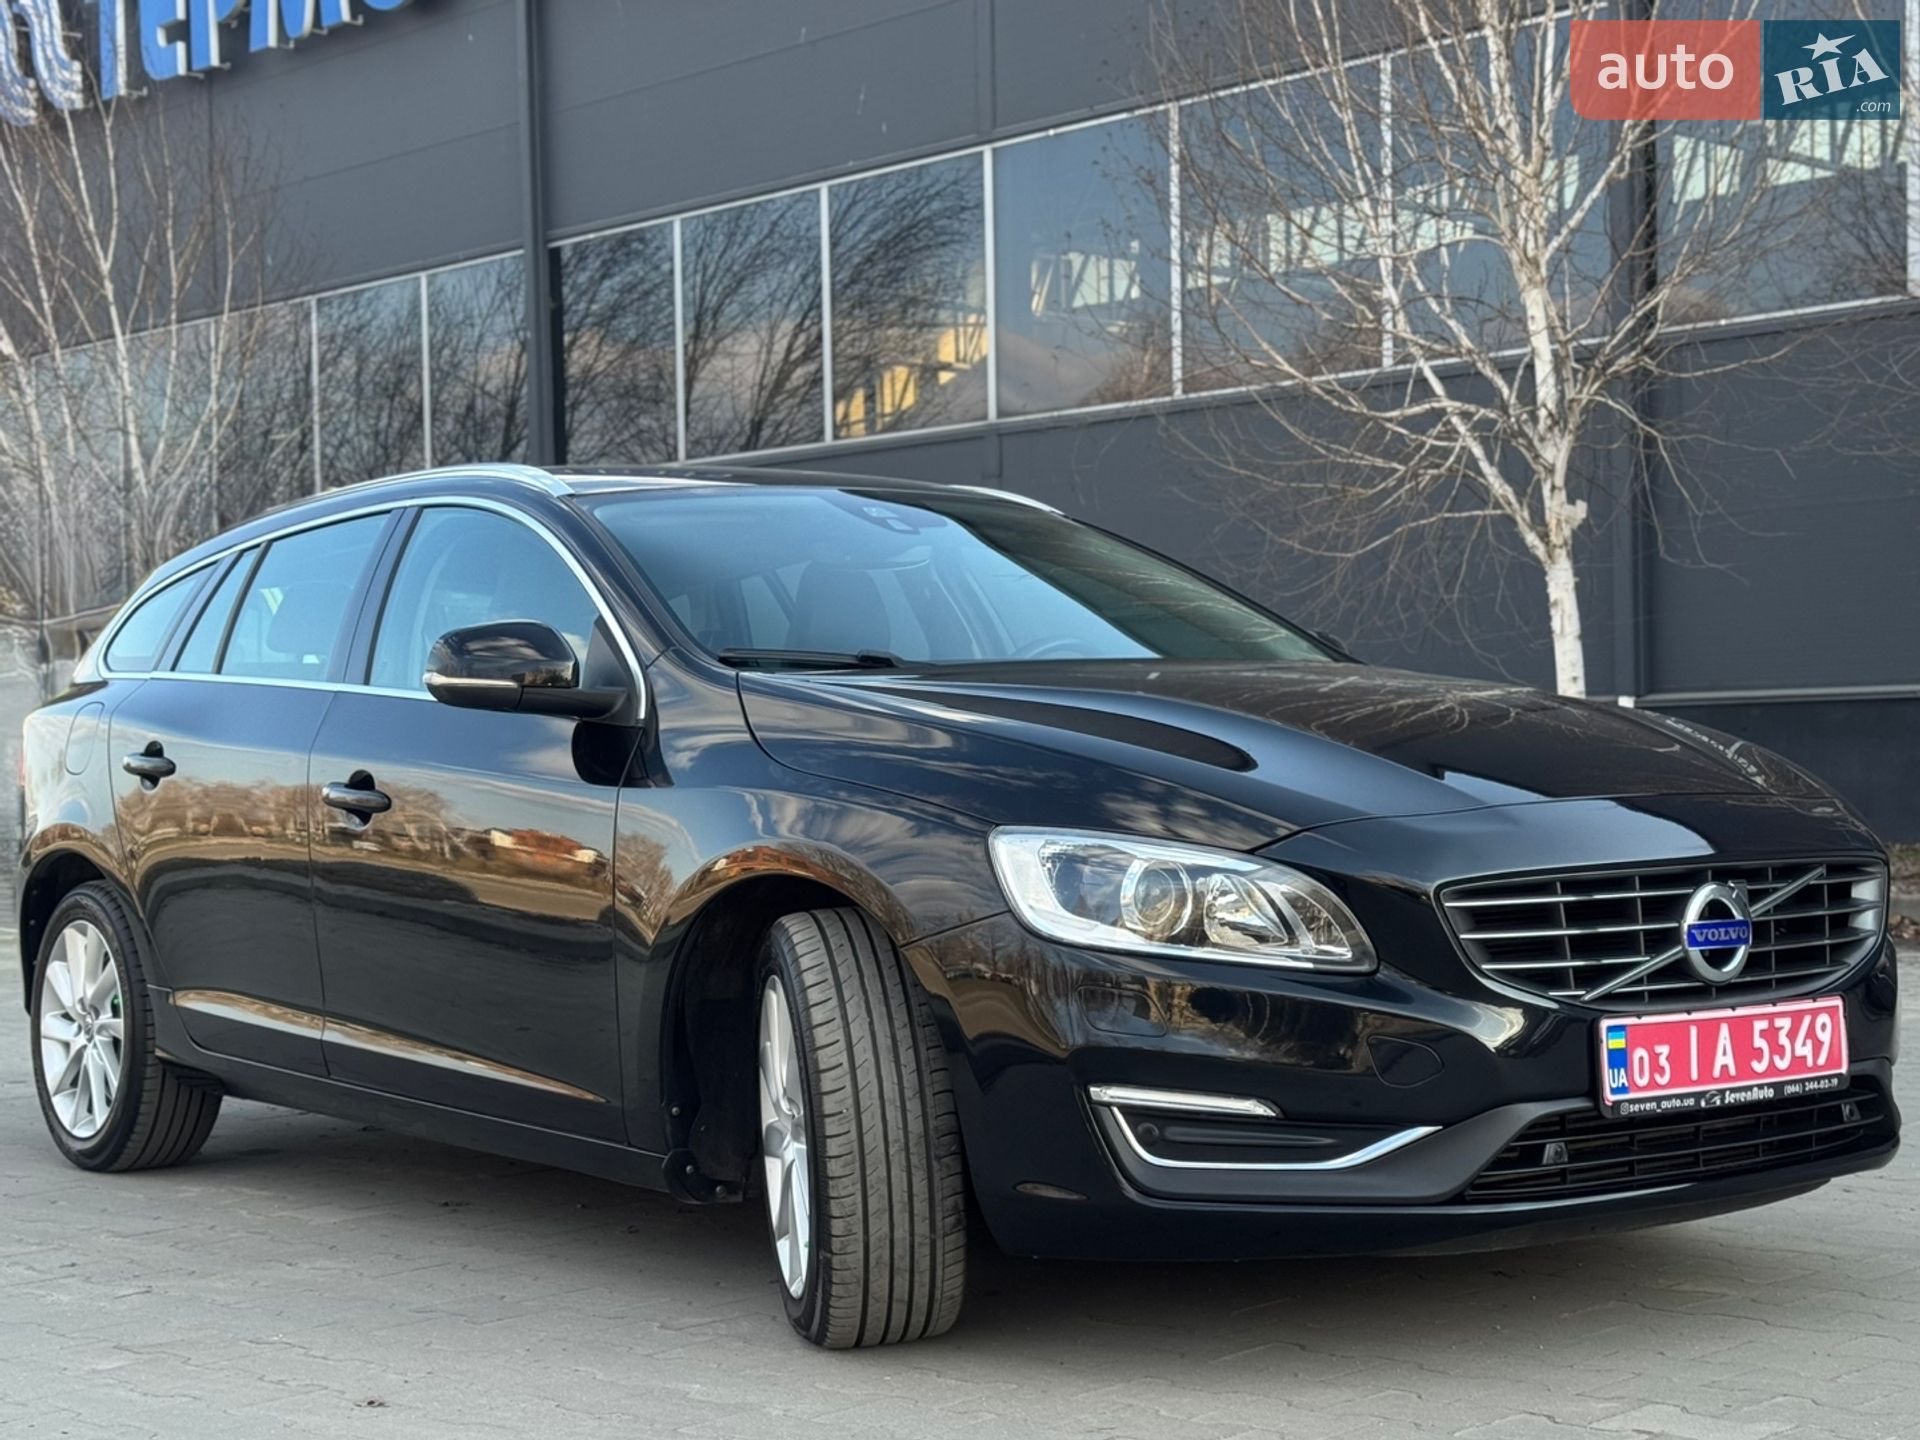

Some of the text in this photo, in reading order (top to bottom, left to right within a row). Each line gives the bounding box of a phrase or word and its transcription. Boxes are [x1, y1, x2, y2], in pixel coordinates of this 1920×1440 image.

[1691, 927, 1748, 942] VOLVO
[1632, 1044, 1671, 1088] 03
[1750, 1012, 1833, 1074] 5349
[1609, 1067, 1628, 1089] UA
[1724, 1086, 1775, 1104] SevenAuto
